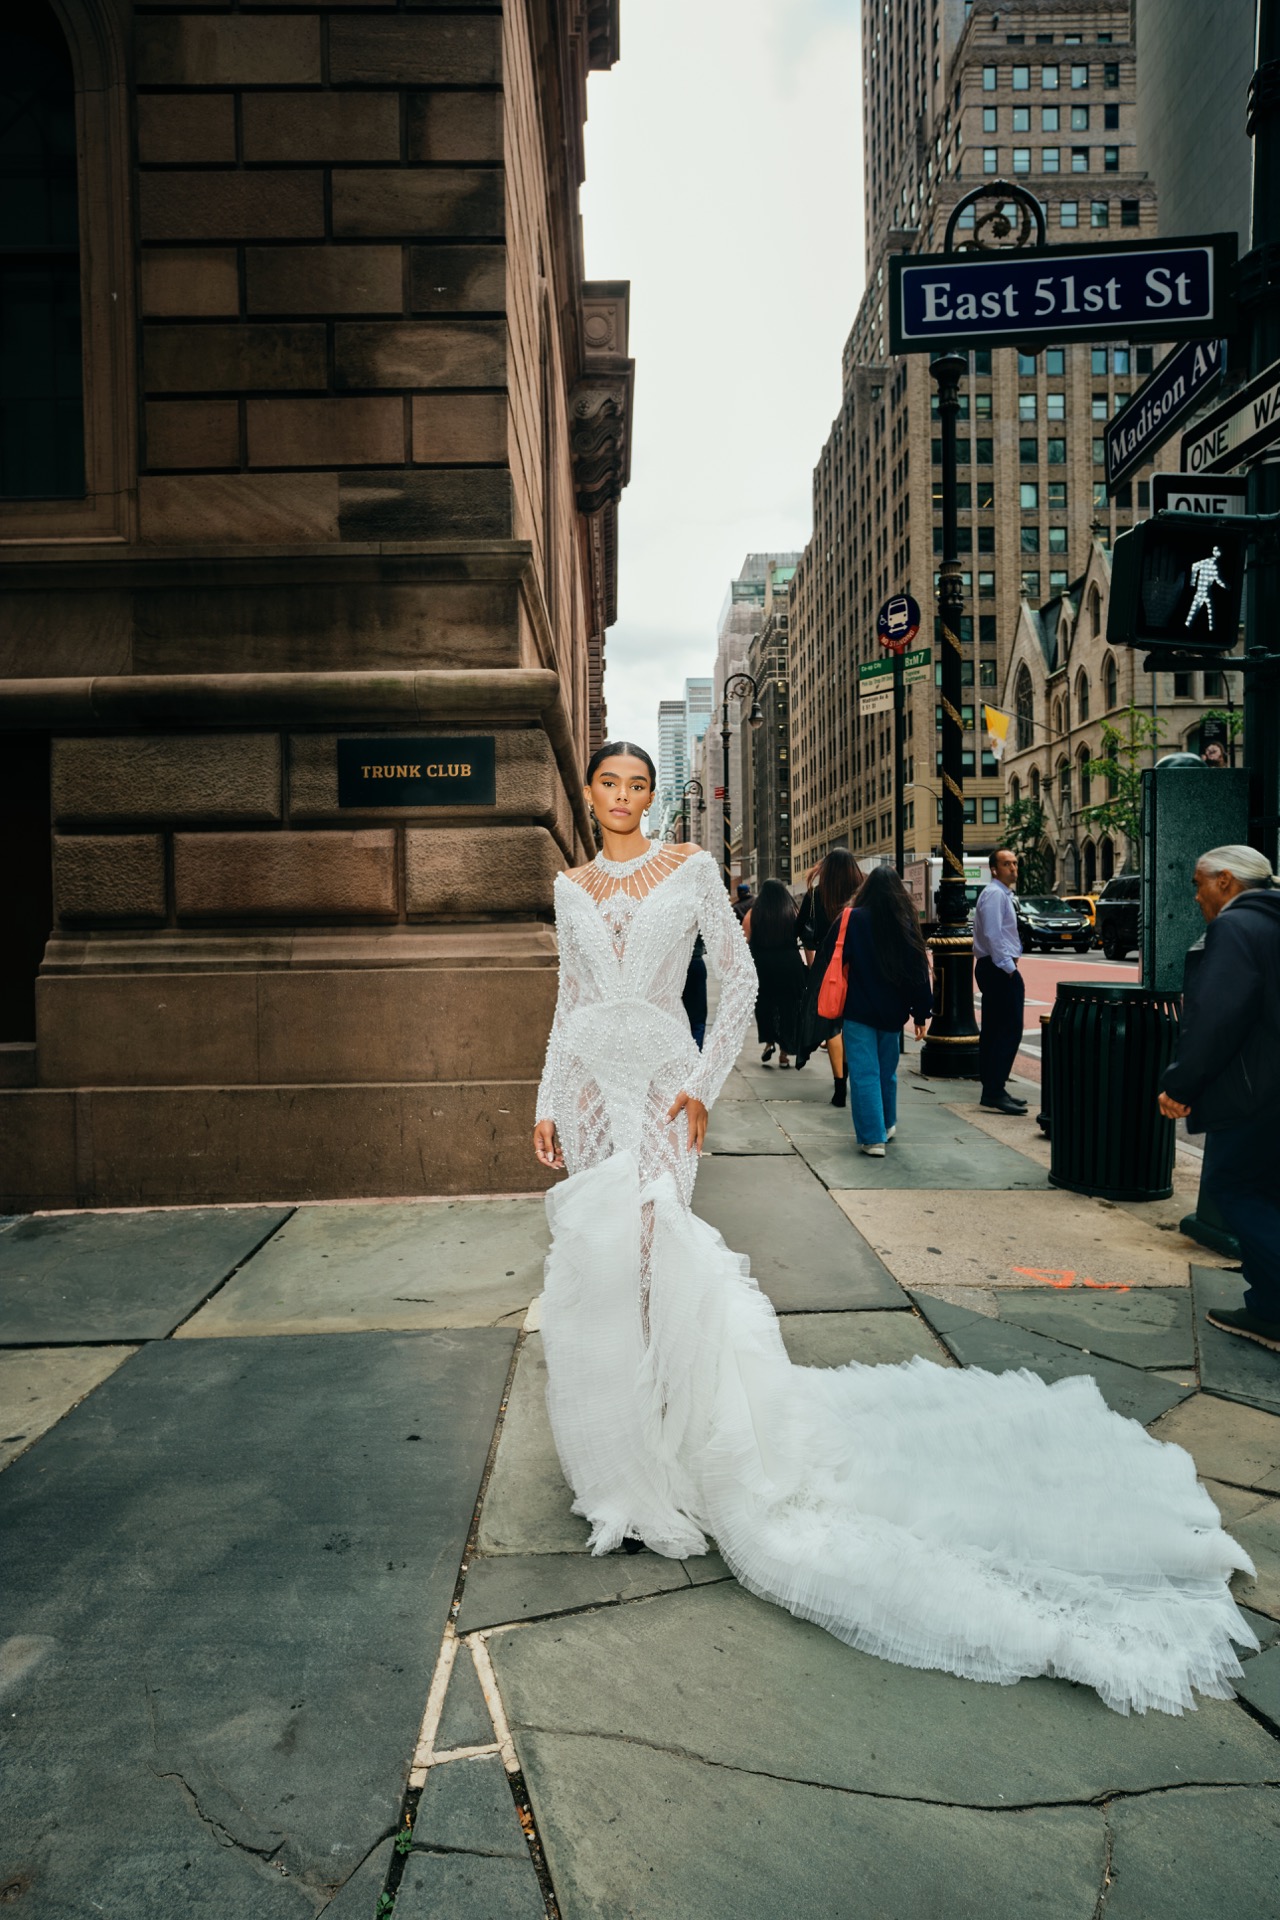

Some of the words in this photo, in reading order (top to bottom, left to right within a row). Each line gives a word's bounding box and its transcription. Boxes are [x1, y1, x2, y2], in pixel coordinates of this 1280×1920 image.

[921, 282, 1019, 322] East
[1034, 275, 1122, 316] 51st
[1145, 267, 1192, 308] St
[1110, 375, 1186, 471] Madison
[1191, 339, 1219, 386] Av
[1191, 423, 1230, 472] ONE
[905, 652, 924, 666] BxM7
[361, 765, 421, 778] TRUNK
[426, 763, 472, 777] CLUB
